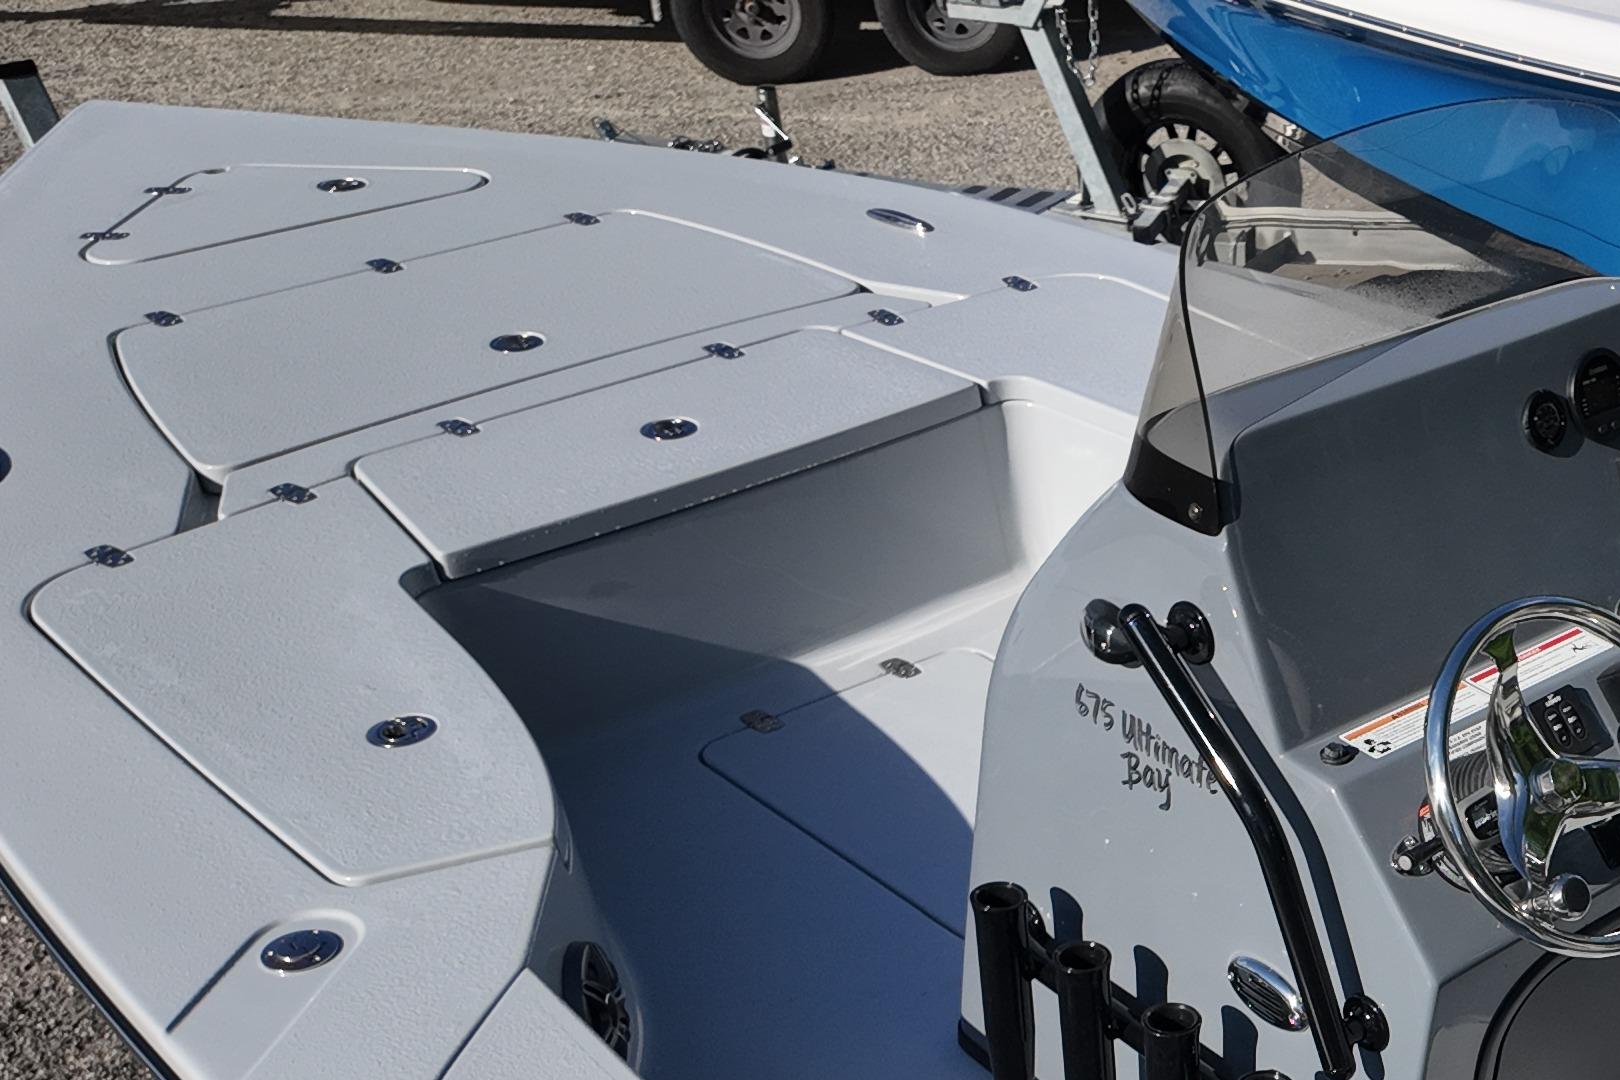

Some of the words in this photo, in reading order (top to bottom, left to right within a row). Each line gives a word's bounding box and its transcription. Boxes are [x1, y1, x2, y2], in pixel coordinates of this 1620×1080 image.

[1074, 683, 1115, 731] 675
[1121, 711, 1218, 795] Ultimate
[1120, 752, 1172, 811] Bay
